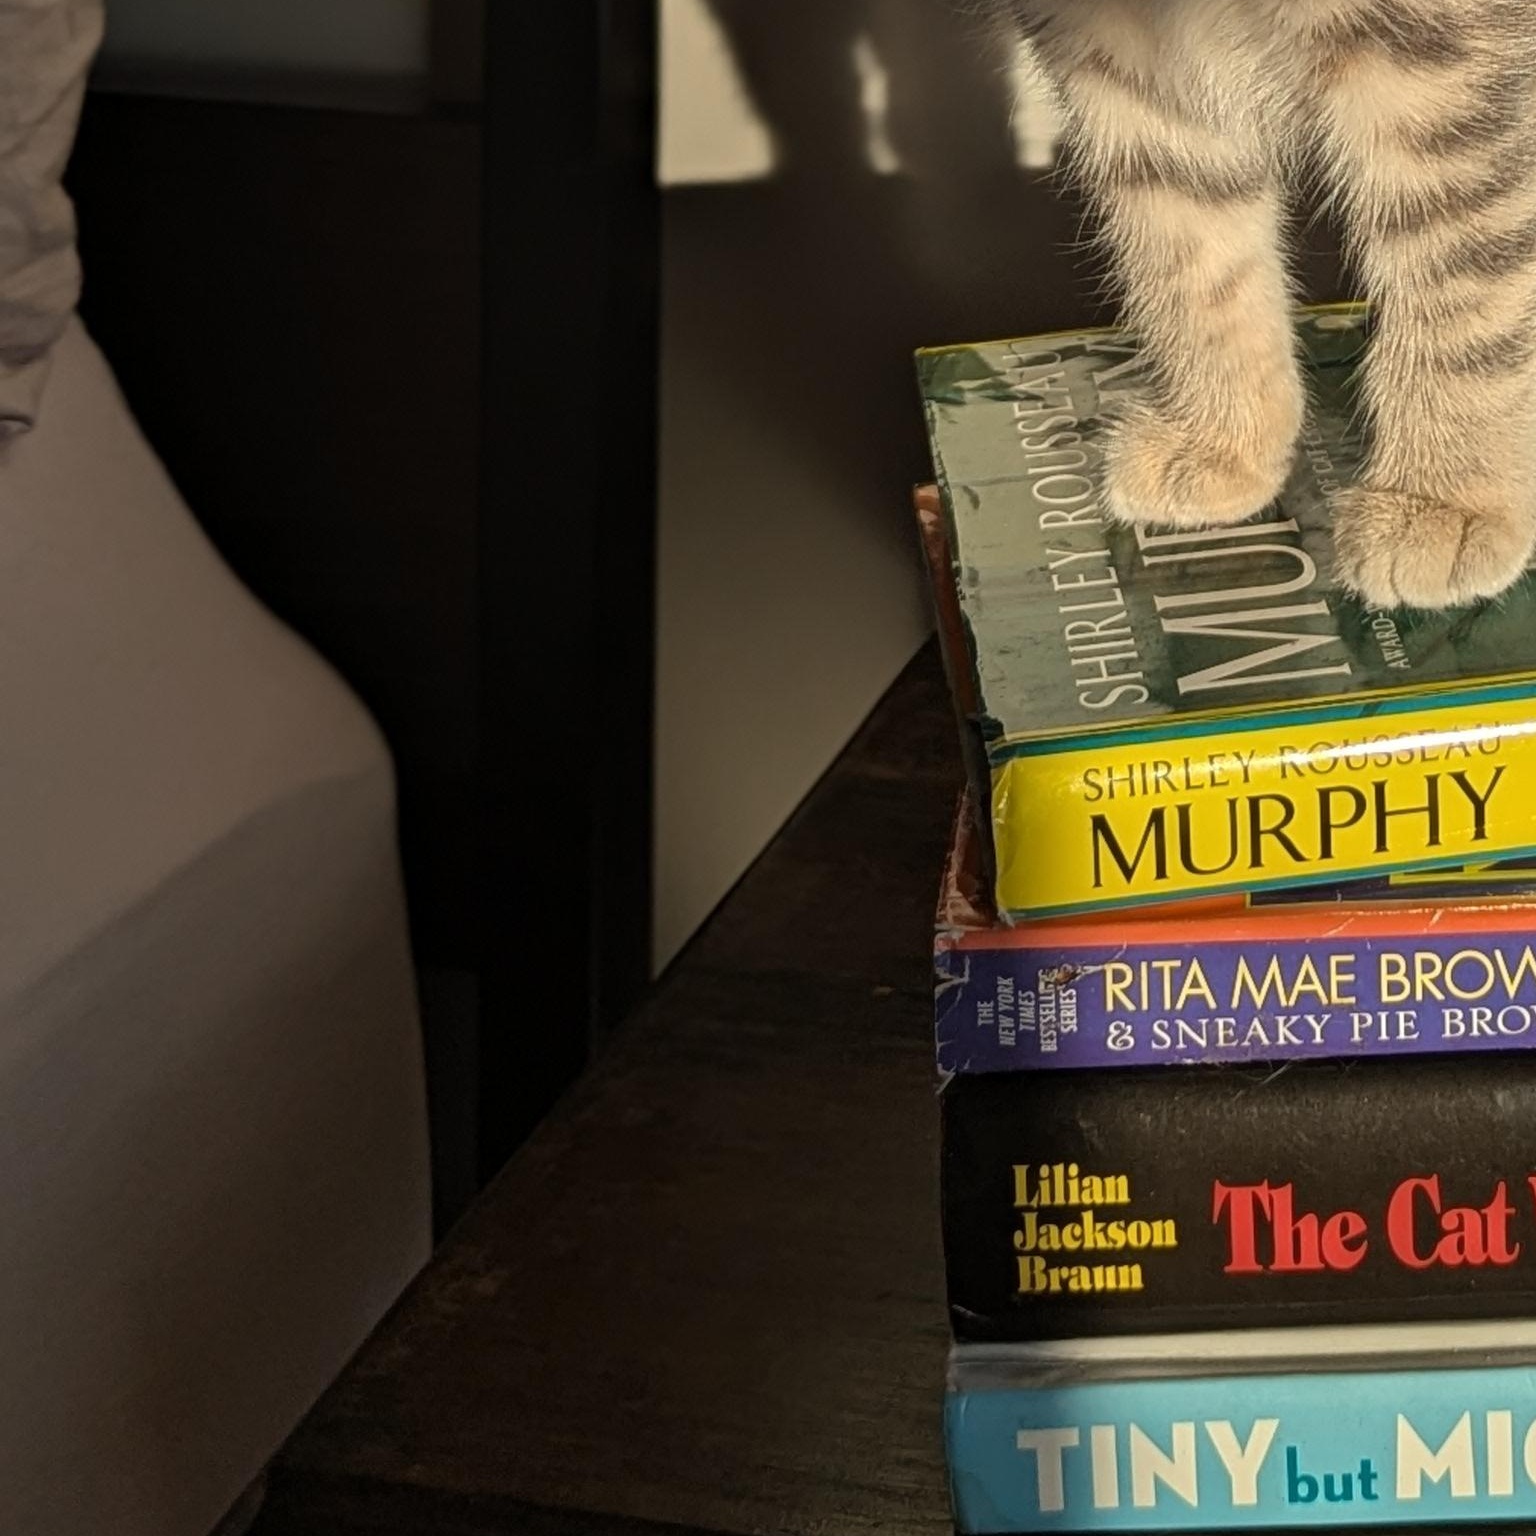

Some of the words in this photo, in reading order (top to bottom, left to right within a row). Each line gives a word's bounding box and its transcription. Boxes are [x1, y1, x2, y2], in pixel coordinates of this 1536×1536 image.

[1002, 351, 1103, 530] ROUSSEAU
[1045, 547, 1149, 709] SHIRLEY
[1082, 748, 1257, 802] SHIRLEY
[1278, 720, 1503, 780] ROUSSEAU
[1089, 764, 1507, 889] MURPHY
[997, 976, 1015, 1012] YORK
[1102, 956, 1217, 1013] RITA
[1230, 953, 1356, 1010] MAE
[977, 1000, 994, 1027] THE
[998, 1014, 1016, 1046] NEW
[1018, 990, 1036, 1031] TIMES
[1060, 988, 1078, 1034] SERIES
[1106, 1020, 1135, 1051] &
[1151, 1013, 1333, 1051] SNEAKY
[1349, 1009, 1420, 1043] PIE
[1012, 1162, 1131, 1208] Lilian
[1013, 1209, 1178, 1251] Jackson
[1212, 1177, 1369, 1273] The
[1386, 1173, 1520, 1268] Cat
[1016, 1254, 1144, 1293] Braun
[1016, 1418, 1281, 1514] TINY
[1286, 1445, 1379, 1506] but
